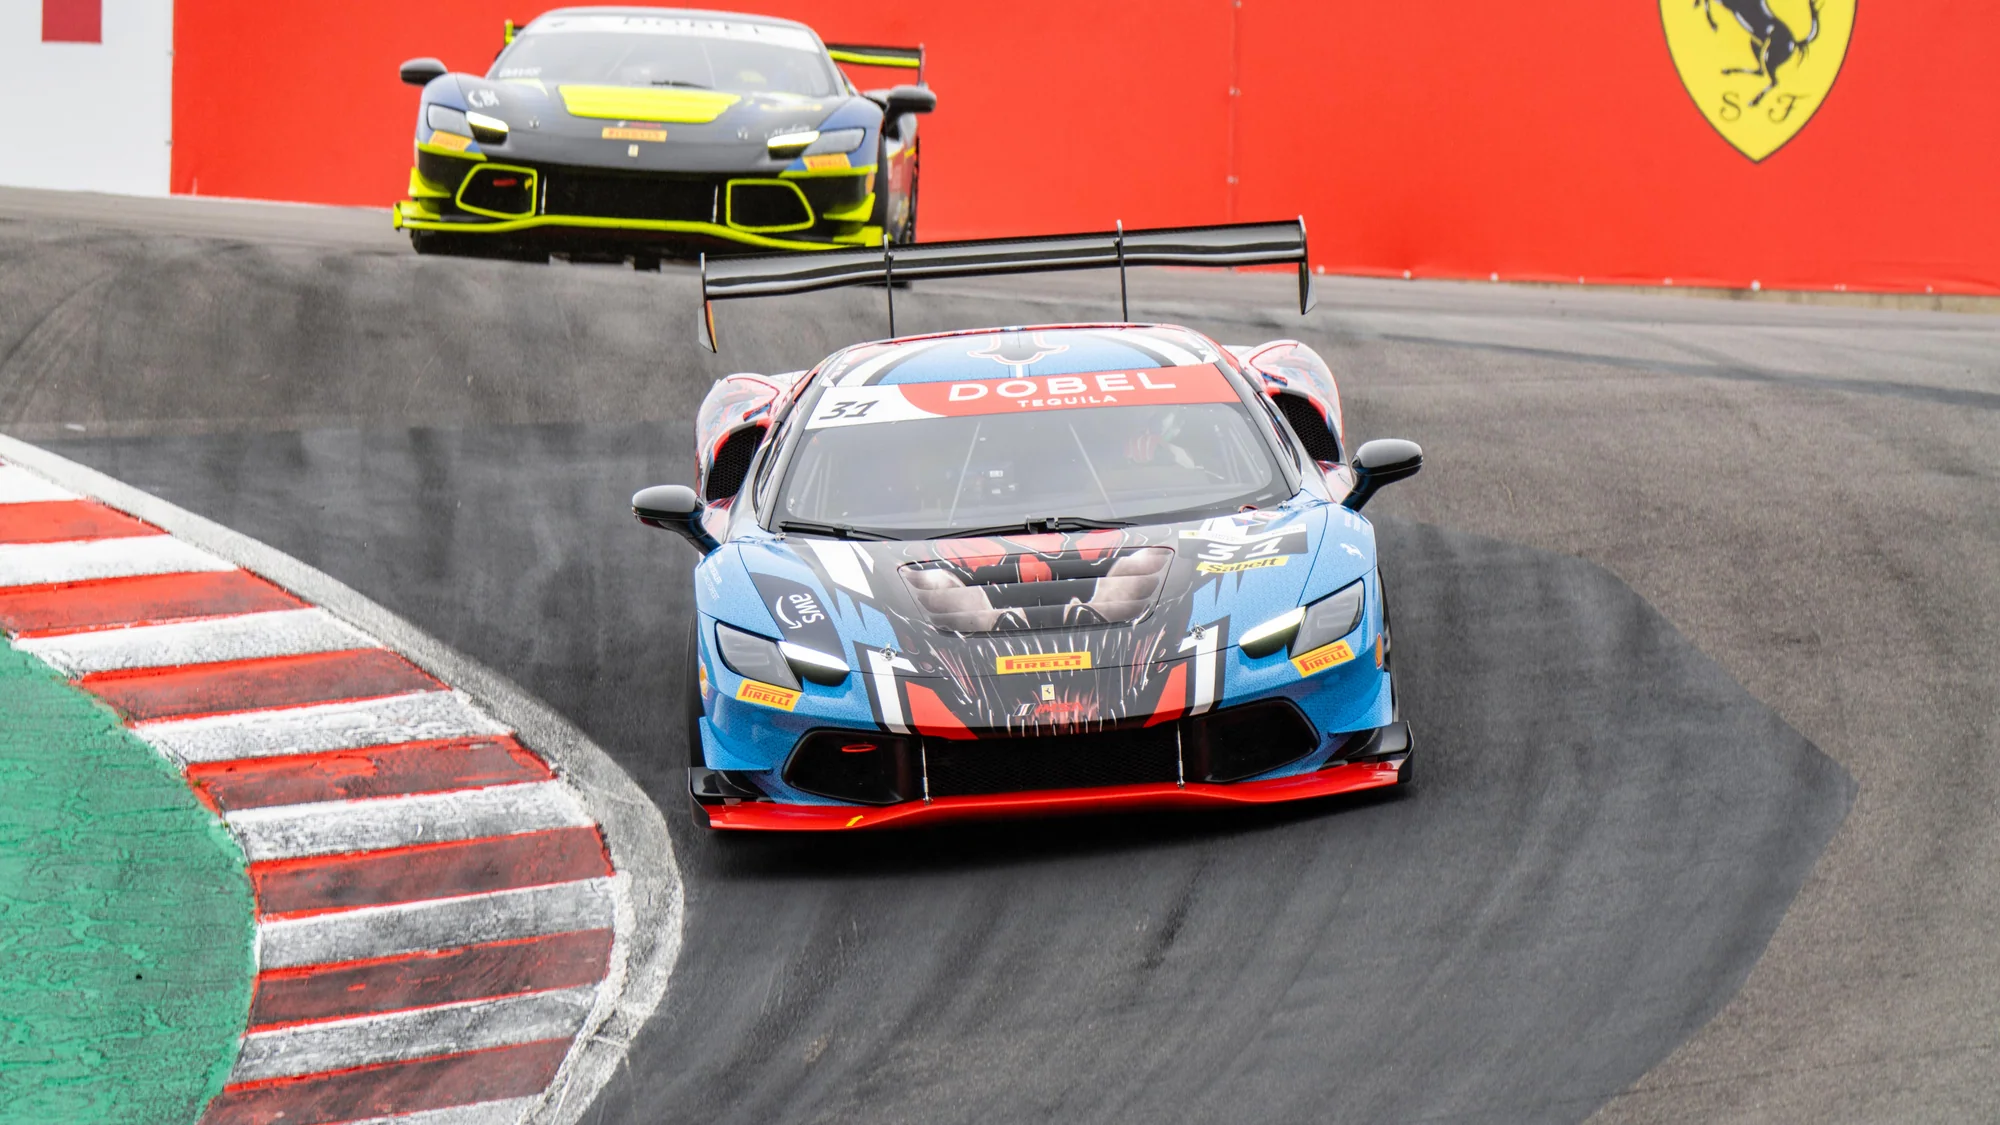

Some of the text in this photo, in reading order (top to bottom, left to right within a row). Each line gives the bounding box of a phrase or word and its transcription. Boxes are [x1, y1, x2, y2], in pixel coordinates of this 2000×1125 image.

[1718, 91, 1742, 122] S
[948, 372, 1177, 402] DOBEL
[818, 399, 880, 421] 31
[1017, 394, 1118, 408] TEQUILA
[1196, 536, 1284, 561] 31
[1206, 556, 1281, 572] Sabelt
[788, 593, 826, 624] aws
[1004, 655, 1082, 670] PIRELLI
[1298, 645, 1349, 672] PIRELLI
[741, 683, 794, 707] PIRELLI
